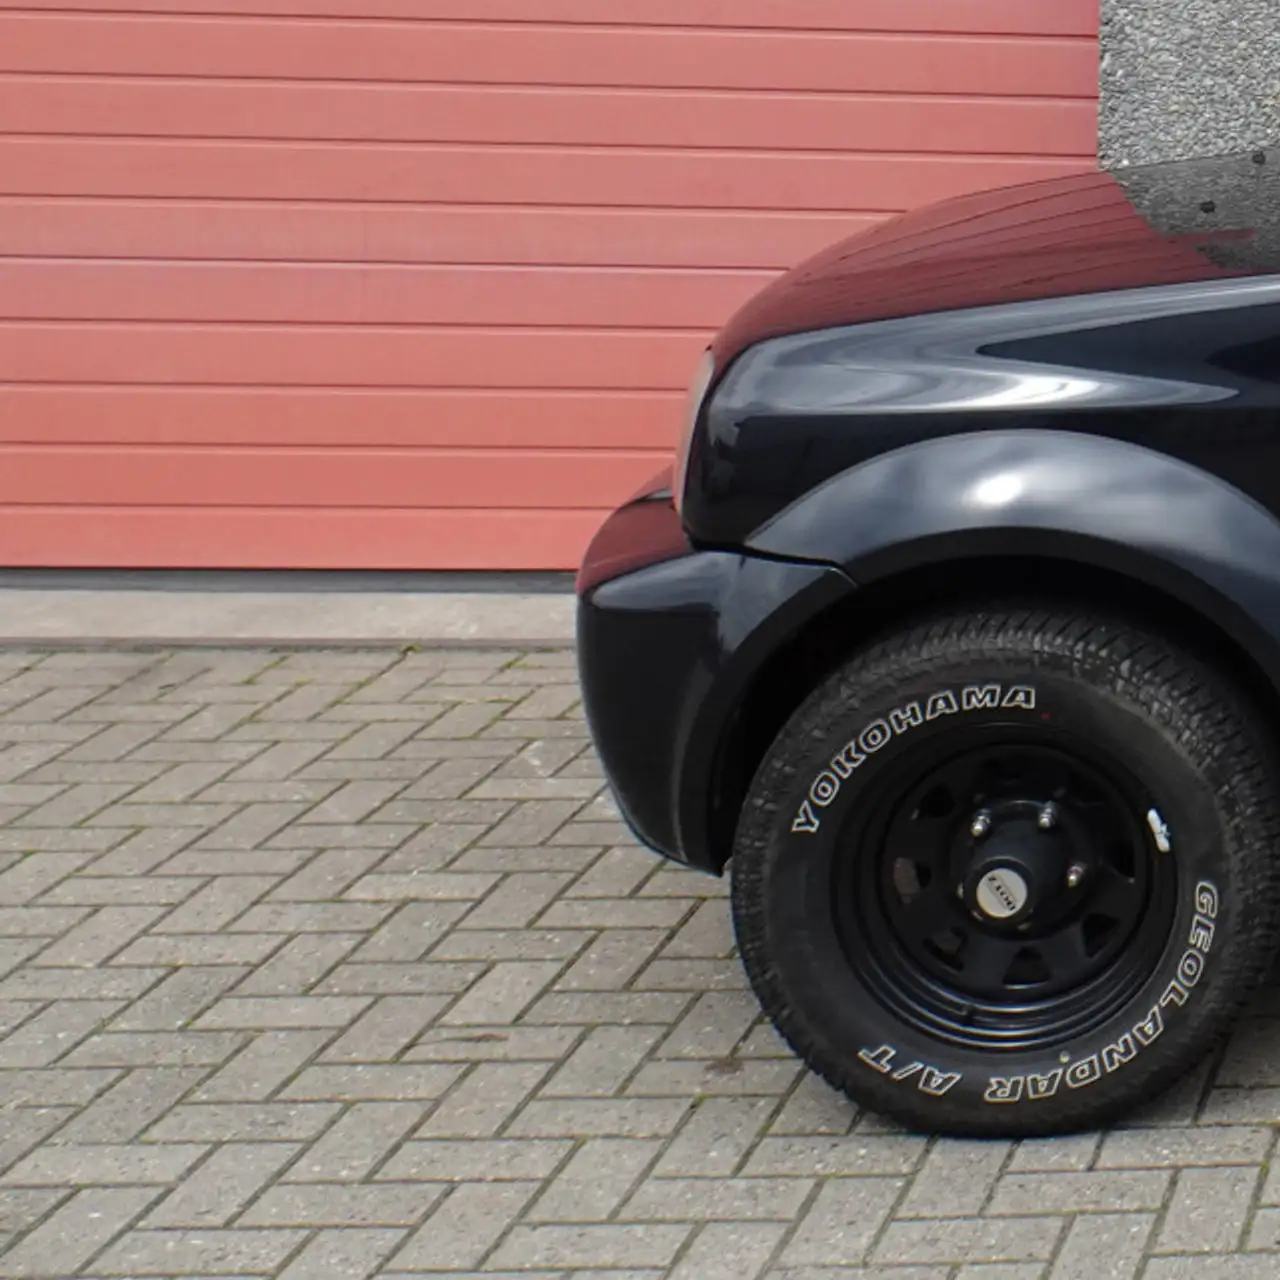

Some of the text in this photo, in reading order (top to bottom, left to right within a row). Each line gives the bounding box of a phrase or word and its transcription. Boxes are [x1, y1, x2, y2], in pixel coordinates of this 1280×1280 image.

[791, 684, 1036, 834] YOKOHAMA
[858, 880, 1219, 1102] GEOLANDAR A/T
